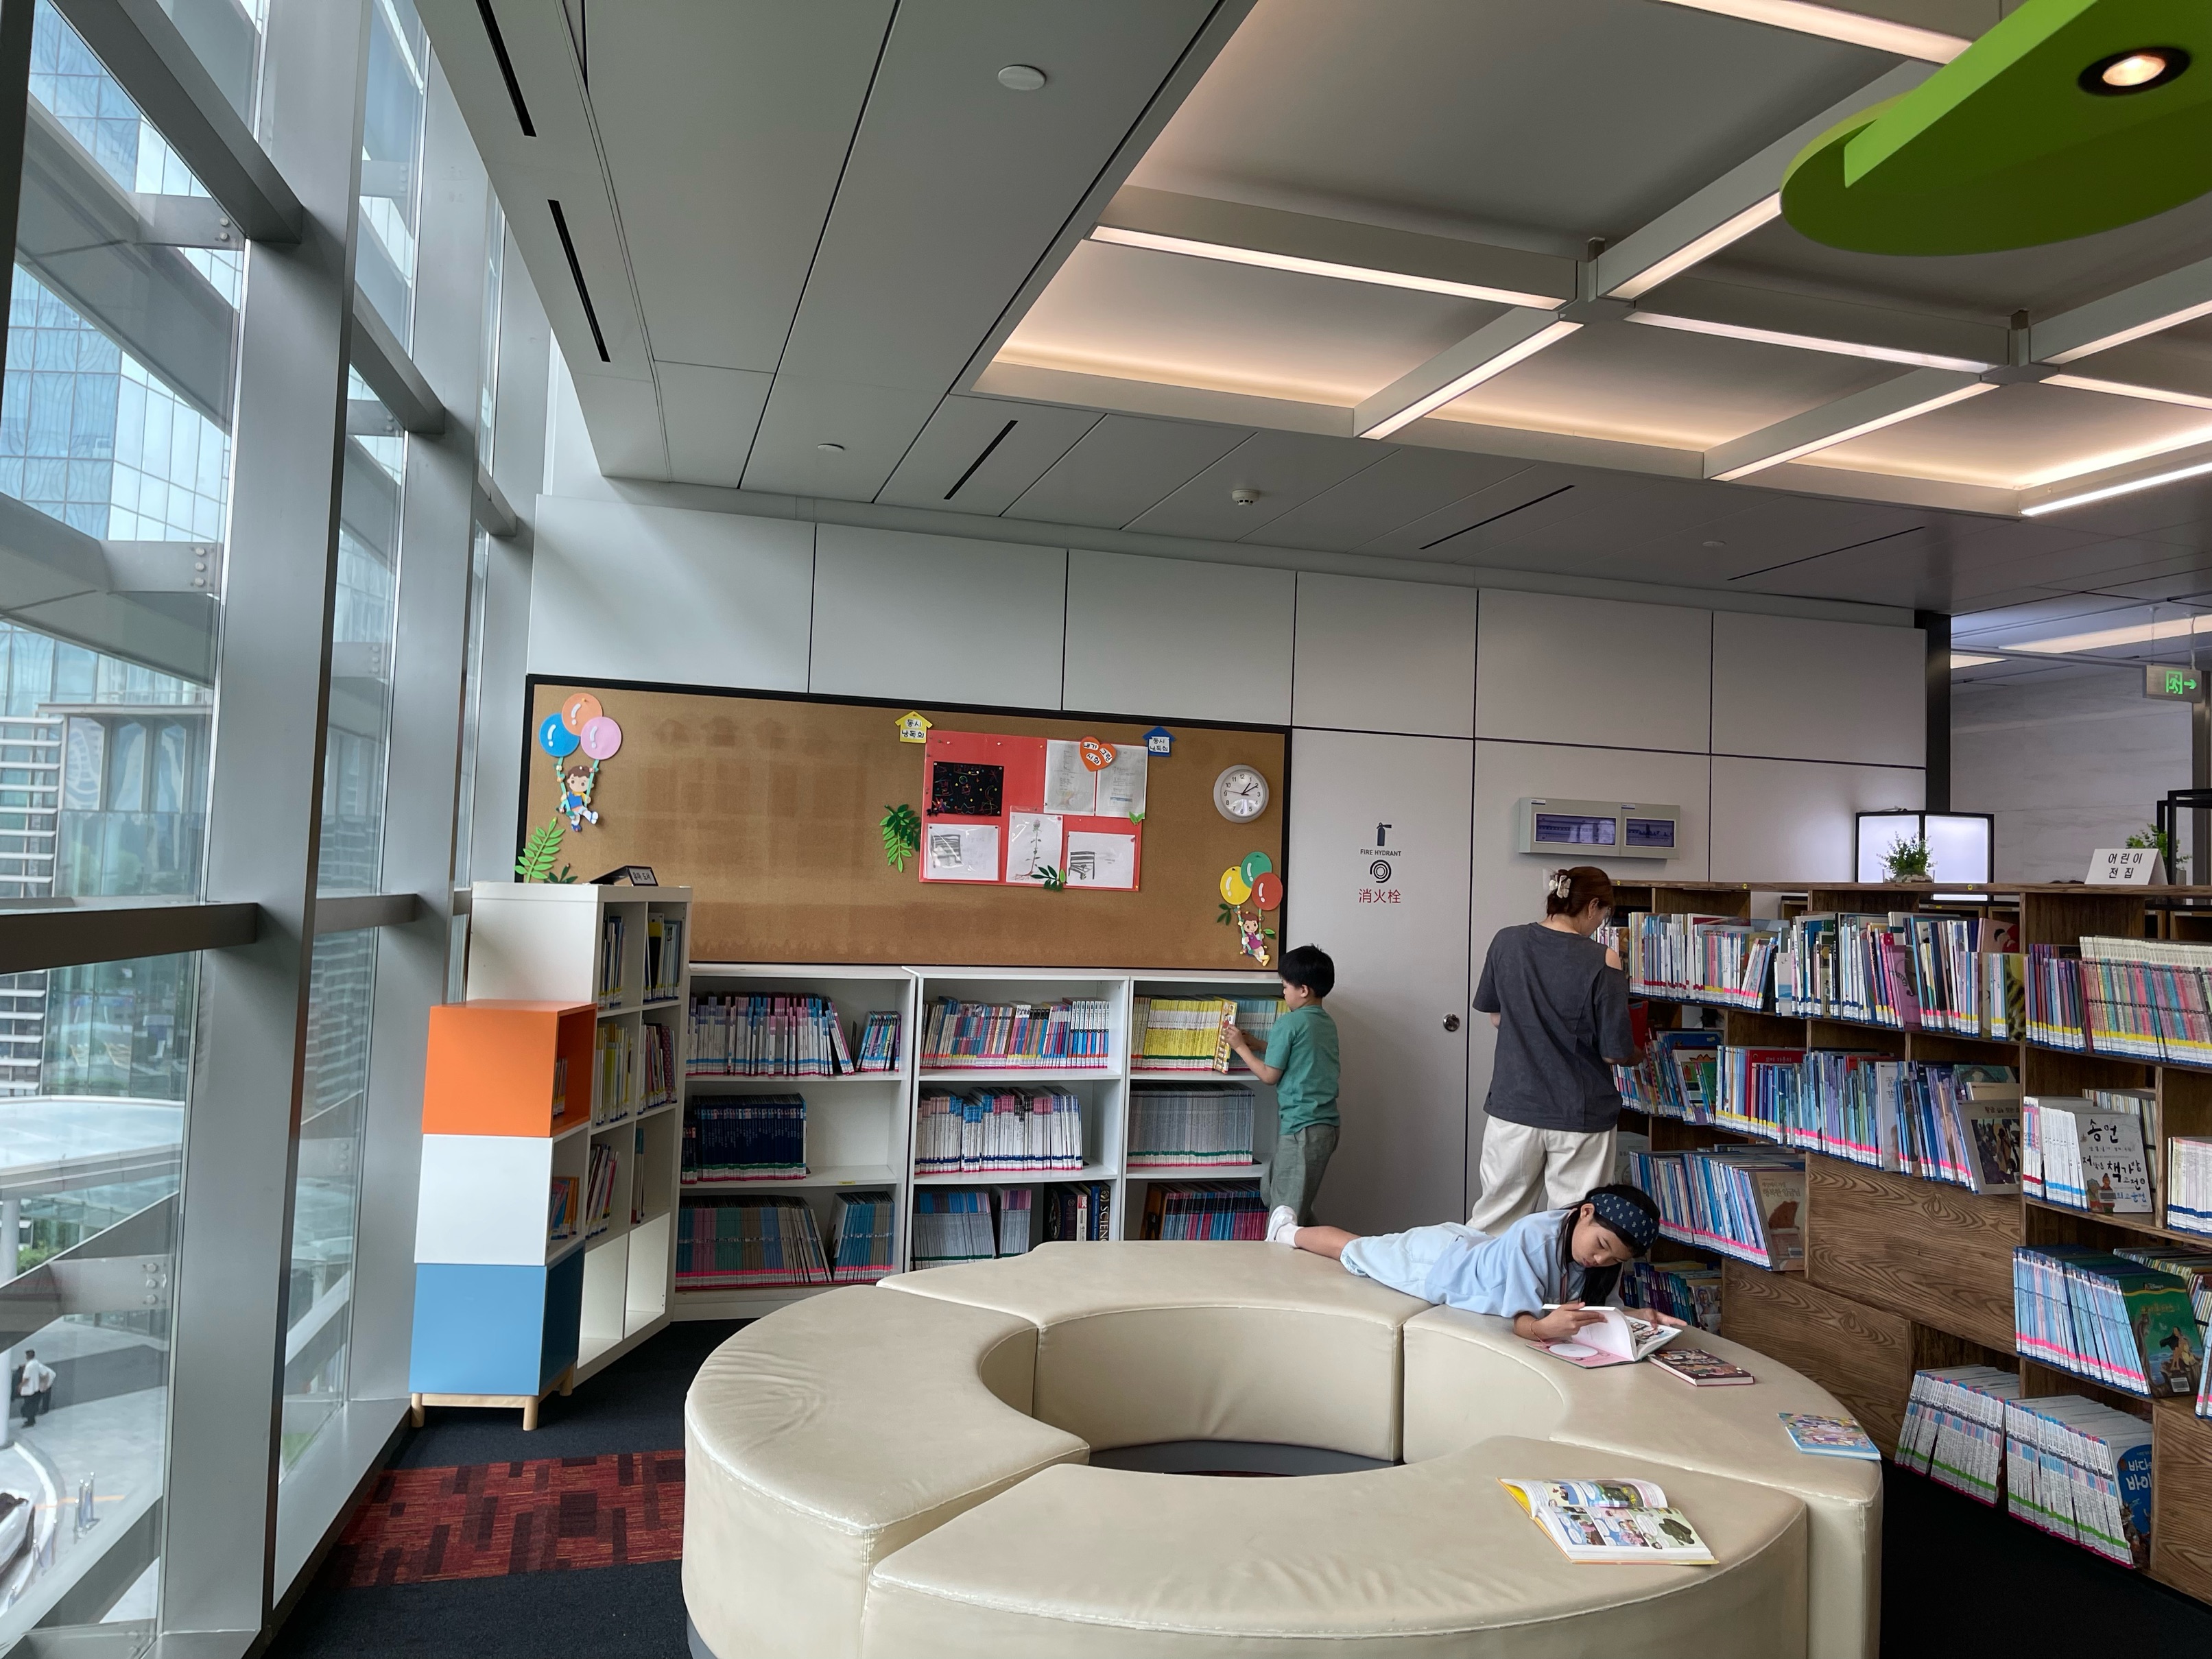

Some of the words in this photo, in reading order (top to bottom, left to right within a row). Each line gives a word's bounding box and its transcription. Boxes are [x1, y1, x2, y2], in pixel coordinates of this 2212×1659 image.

[907, 719, 922, 728] 동시
[901, 729, 925, 739] 낭독회
[2108, 852, 2143, 864] 어린이
[2108, 867, 2134, 879] 전집
[1358, 888, 1401, 904] 消火栓
[2087, 1119, 2119, 1144] 송언
[2106, 1159, 2142, 1183] 책가방
[2128, 1457, 2152, 1472] 바다
